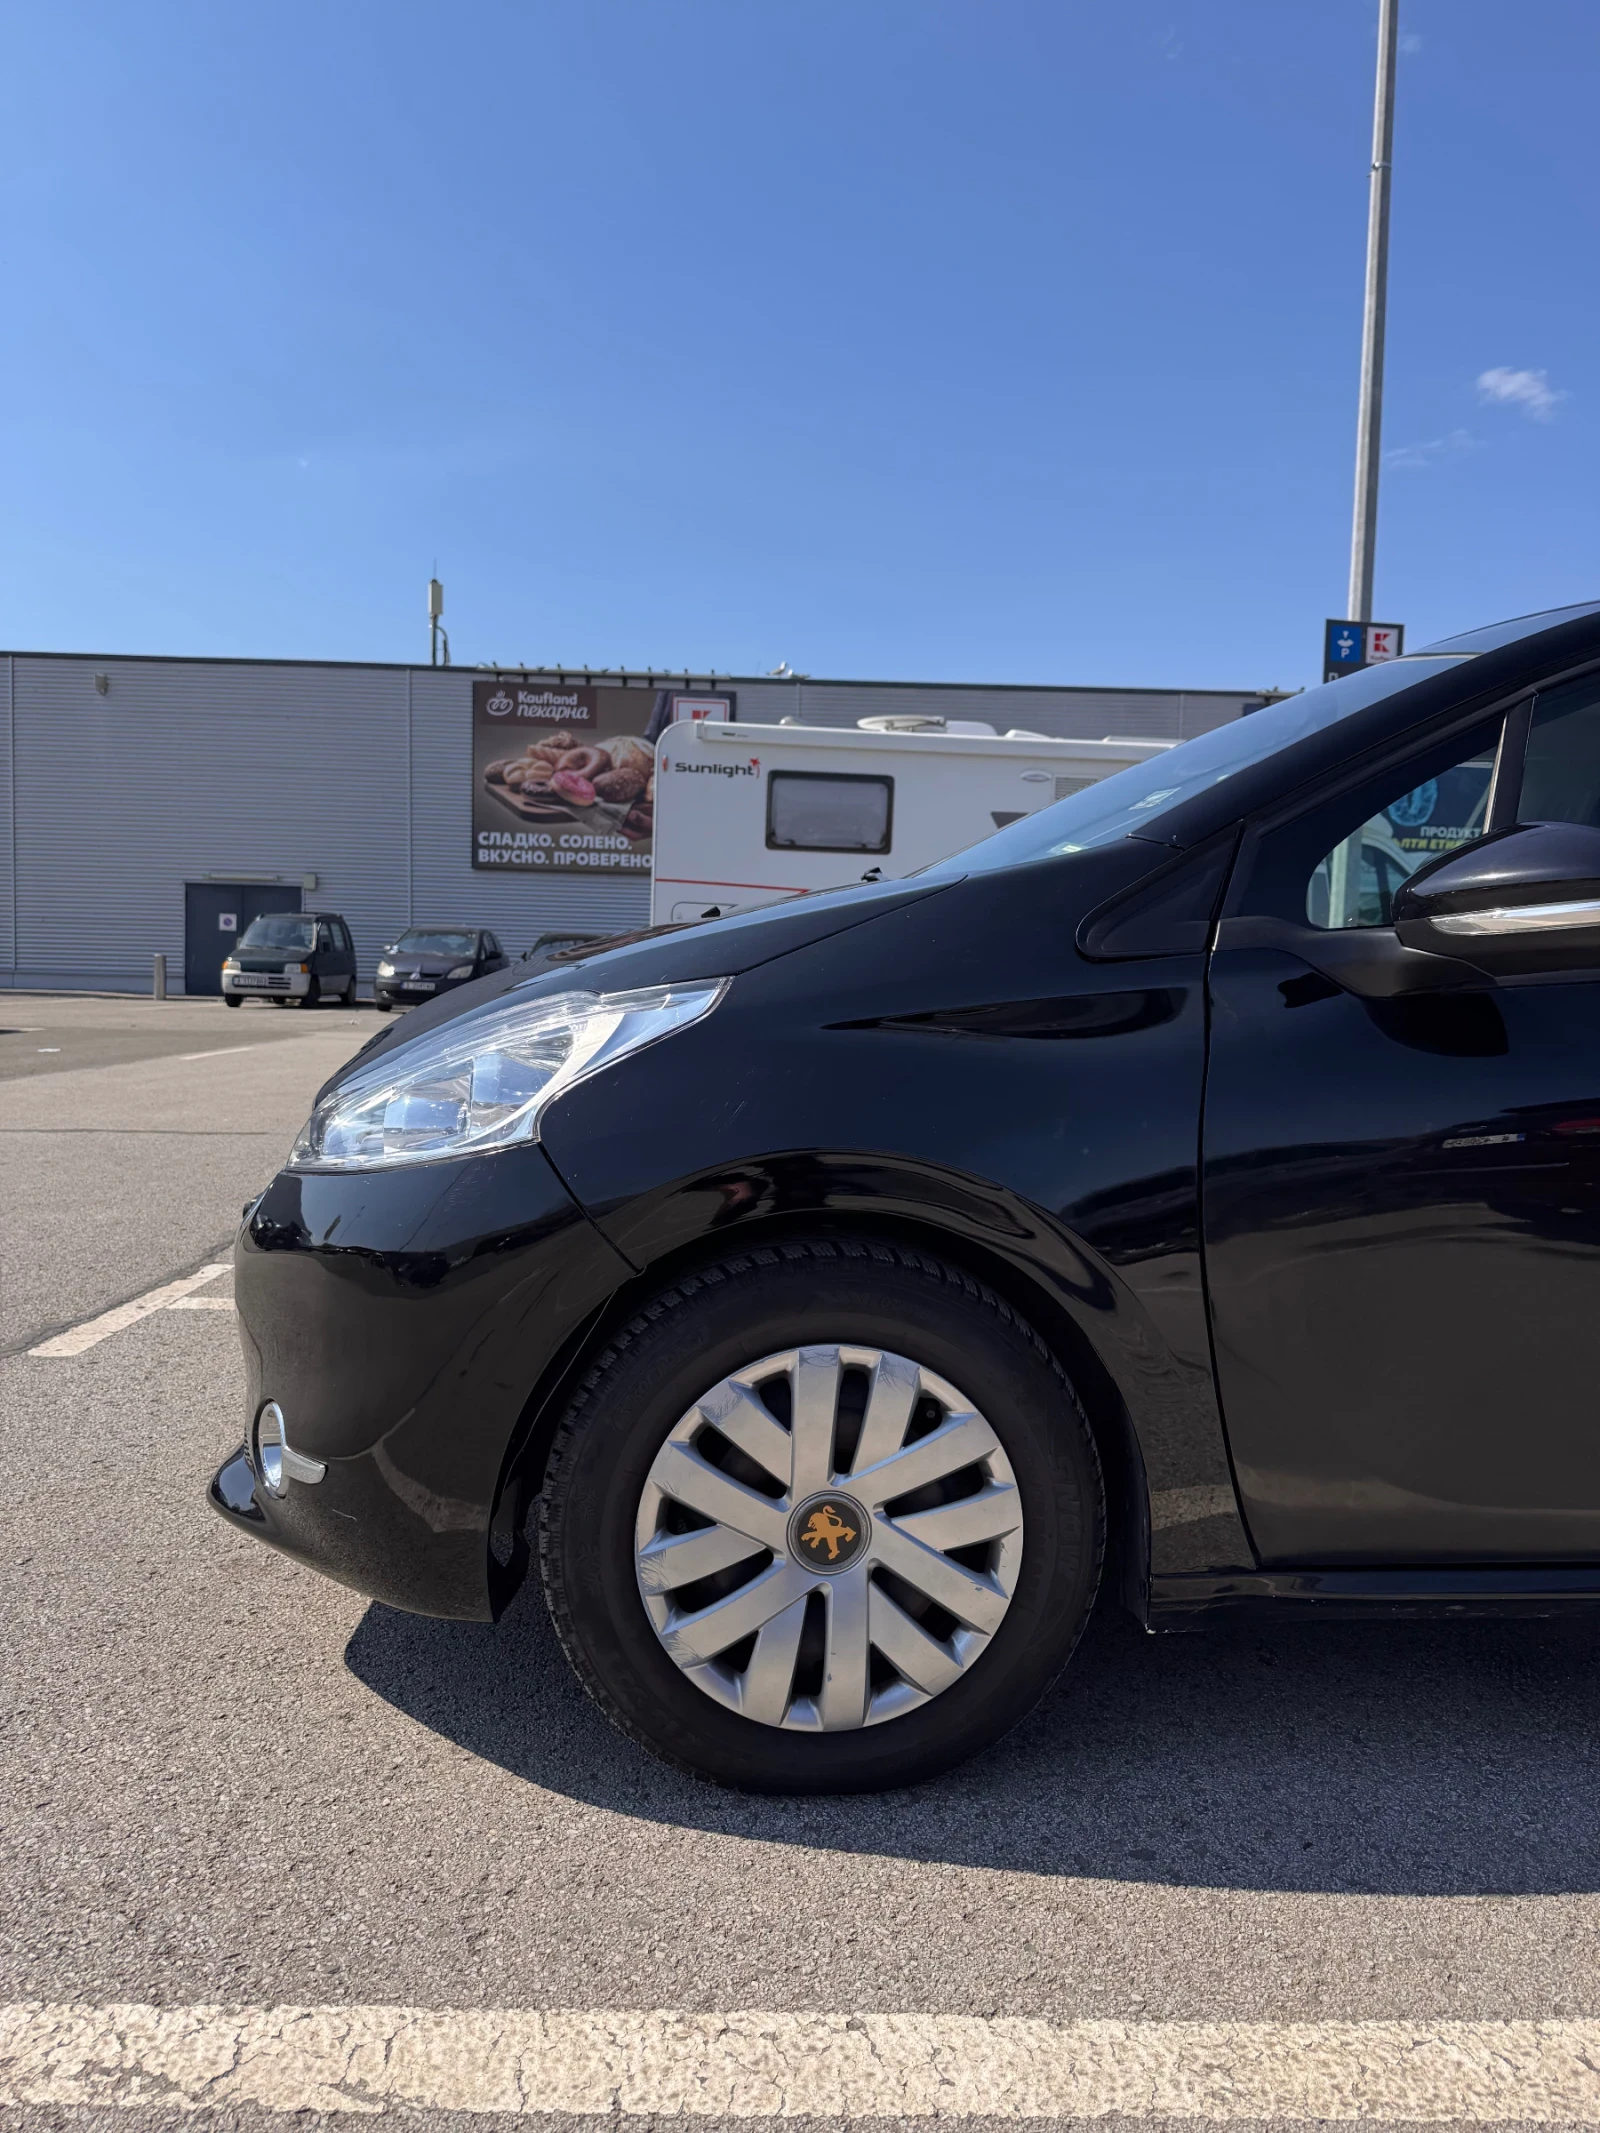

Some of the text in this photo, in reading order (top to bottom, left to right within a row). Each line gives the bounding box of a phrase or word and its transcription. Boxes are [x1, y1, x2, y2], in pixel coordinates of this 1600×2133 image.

[517, 690, 578, 706] Kaufland
[516, 703, 590, 722] пекарна
[675, 762, 754, 778] Sunlight
[477, 831, 633, 850] СЛАДКО. СОЛЕНО.
[477, 848, 550, 865] ВКУСНО.
